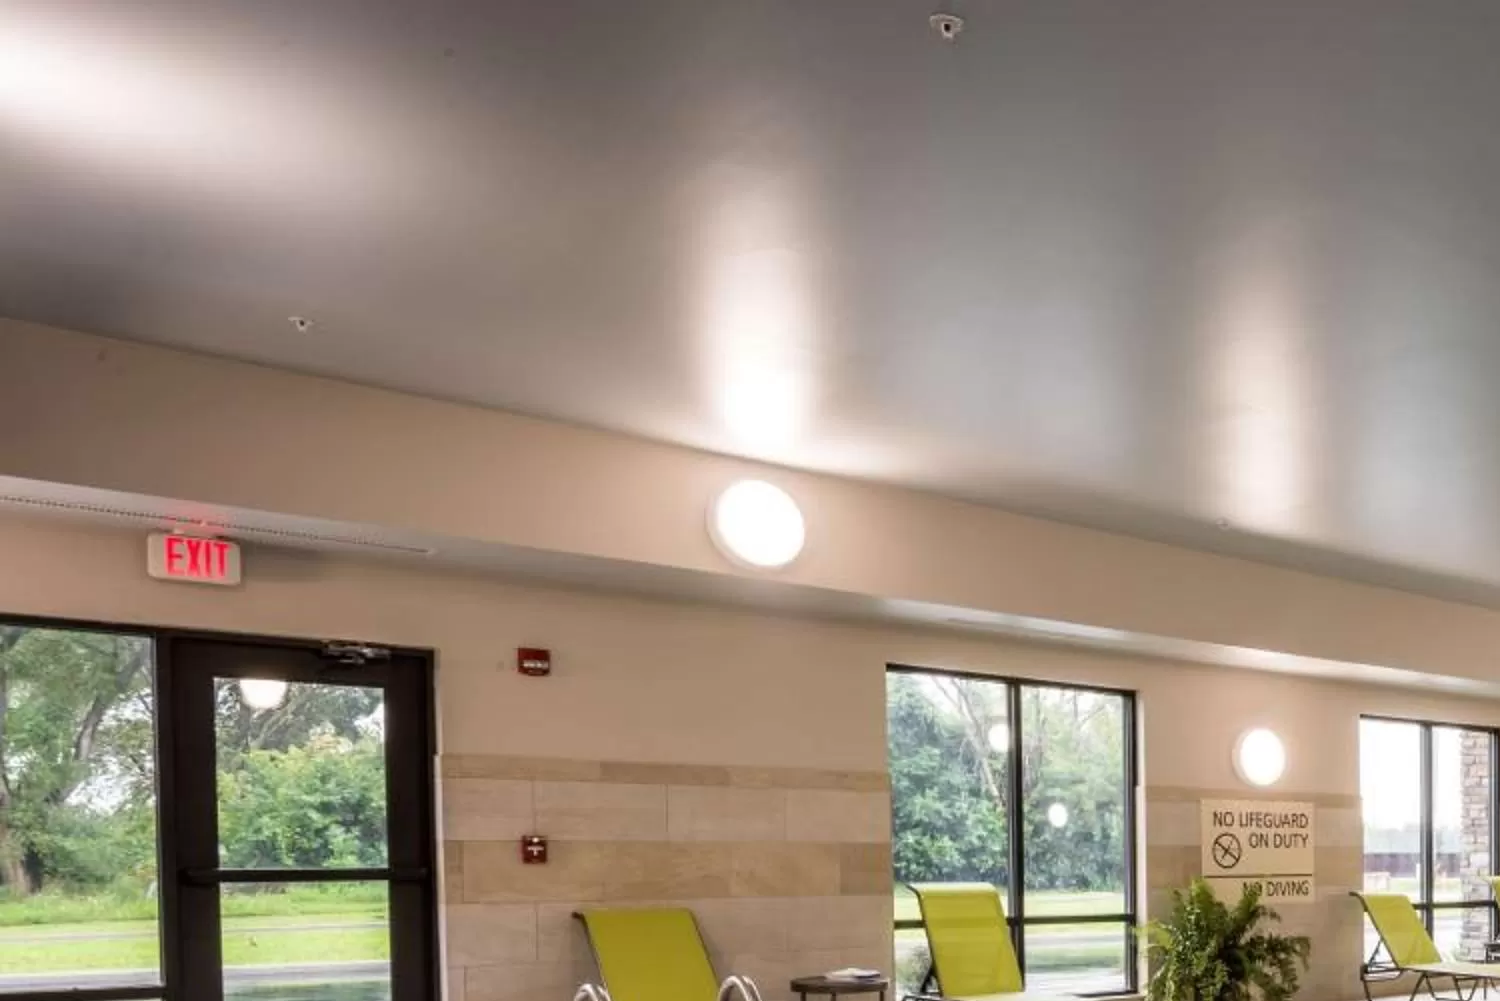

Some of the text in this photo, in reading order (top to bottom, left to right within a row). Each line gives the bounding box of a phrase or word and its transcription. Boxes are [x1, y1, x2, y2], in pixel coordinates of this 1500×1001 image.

[164, 536, 231, 578] EXIT
[1212, 811, 1309, 829] NO LIFEGUARD
[1248, 832, 1309, 848] ON DUTY
[1243, 880, 1309, 896] NO DIVING
